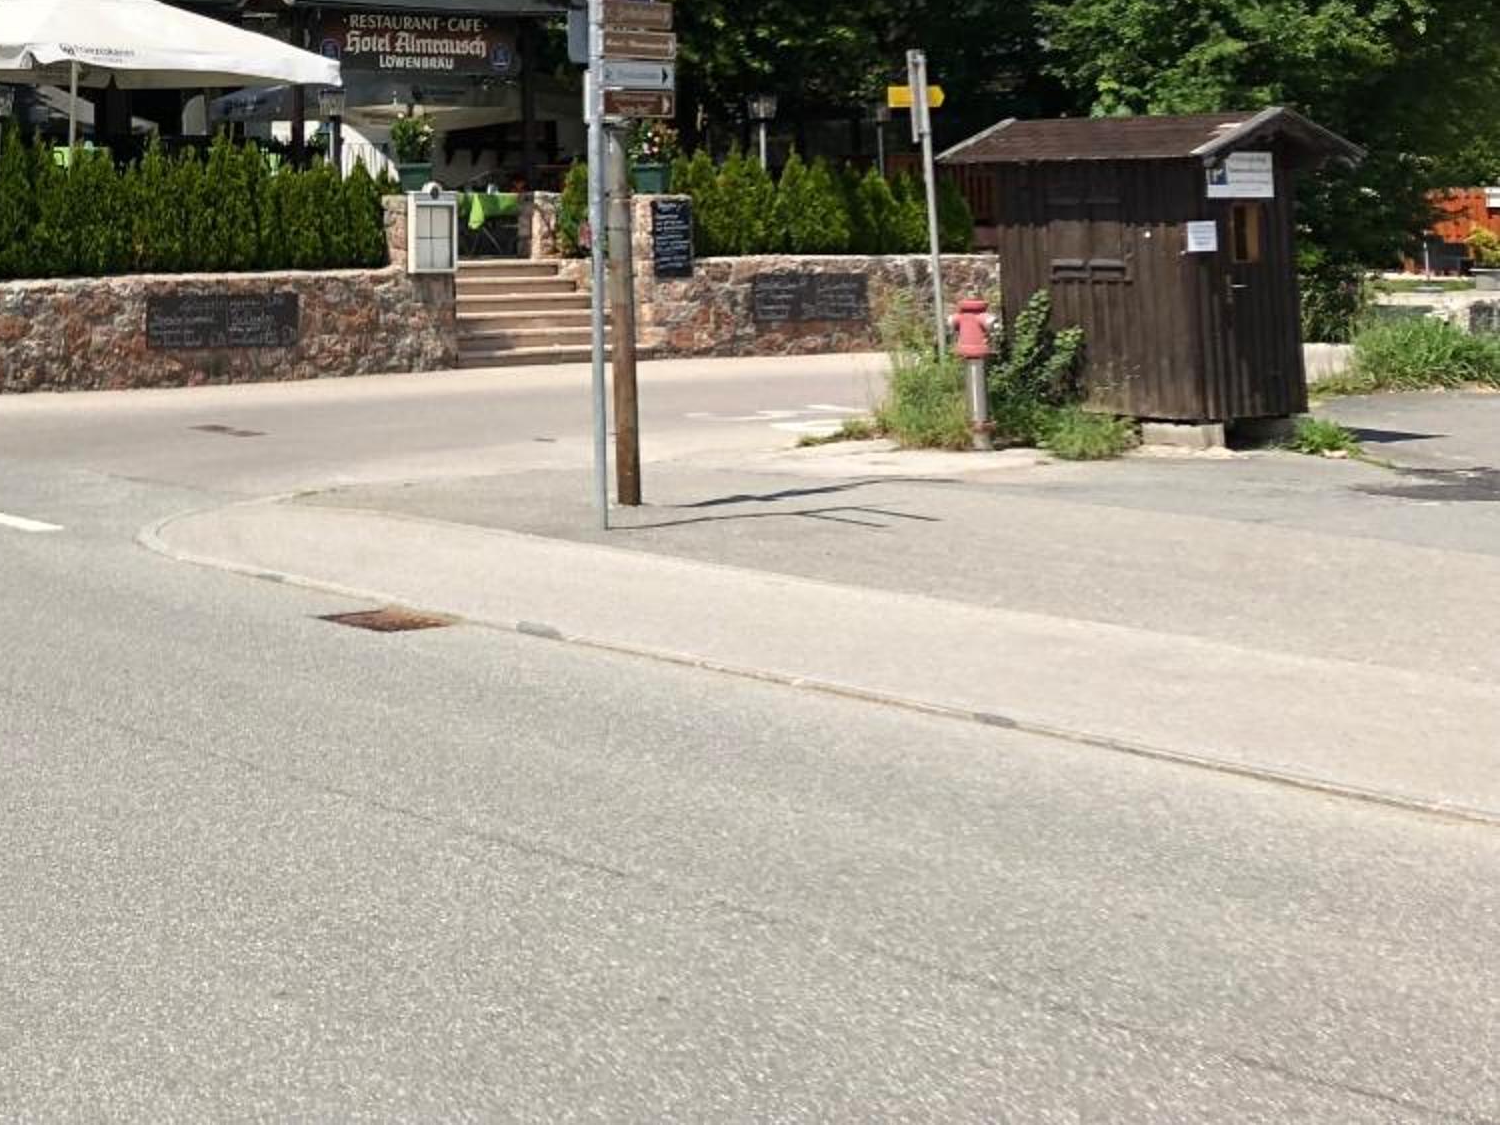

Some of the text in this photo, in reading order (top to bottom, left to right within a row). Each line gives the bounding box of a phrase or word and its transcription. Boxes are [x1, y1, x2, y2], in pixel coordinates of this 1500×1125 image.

[349, 14, 439, 31] RESTAURANT
[343, 30, 486, 58] Hotel Almrausch
